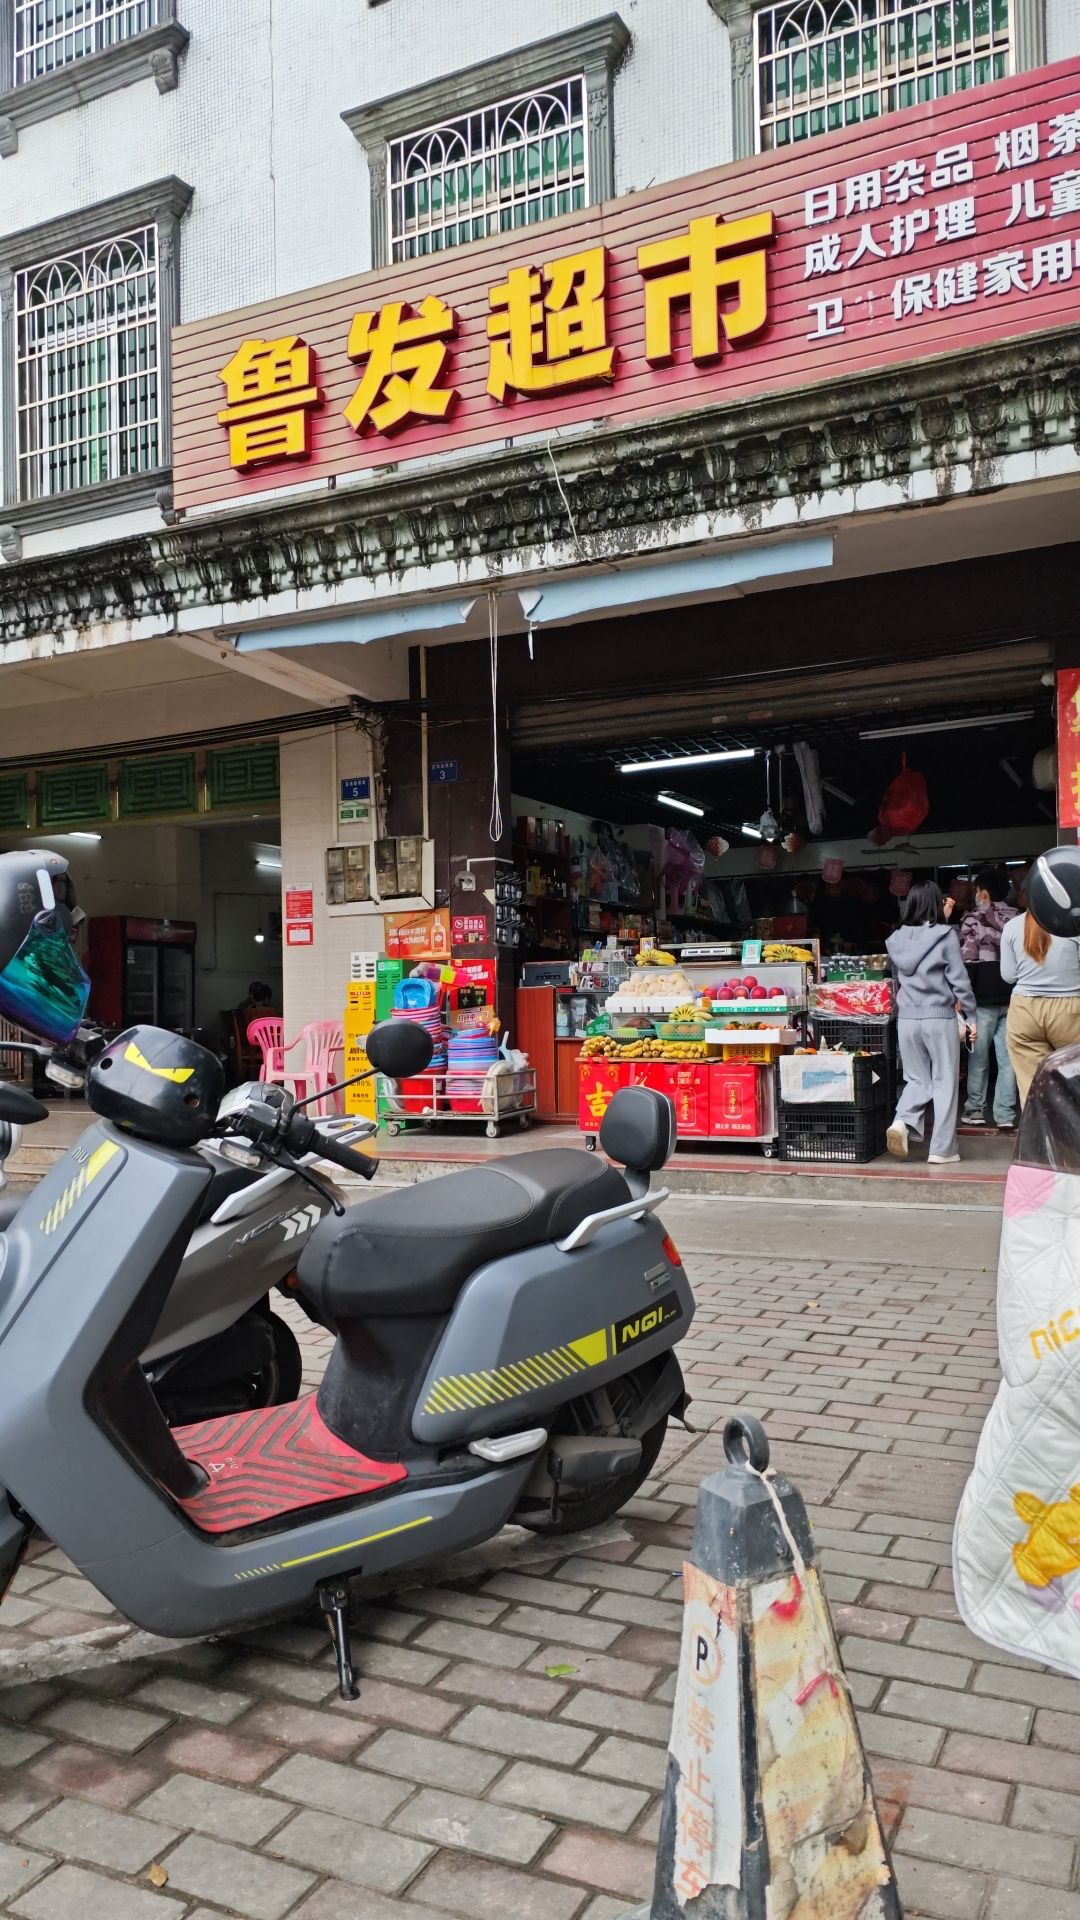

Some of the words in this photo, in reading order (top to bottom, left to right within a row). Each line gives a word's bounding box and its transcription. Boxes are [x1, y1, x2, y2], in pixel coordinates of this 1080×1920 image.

[804, 142, 975, 226] 日用杂品
[804, 196, 977, 280] 成人护理
[216, 210, 776, 472] 鲁发超市
[352, 787, 359, 797] 5
[439, 770, 446, 780] 3
[585, 1081, 614, 1117] 吉
[71, 1145, 91, 1164] niu
[1028, 1307, 1080, 1360] nic
[696, 1634, 708, 1672] P
